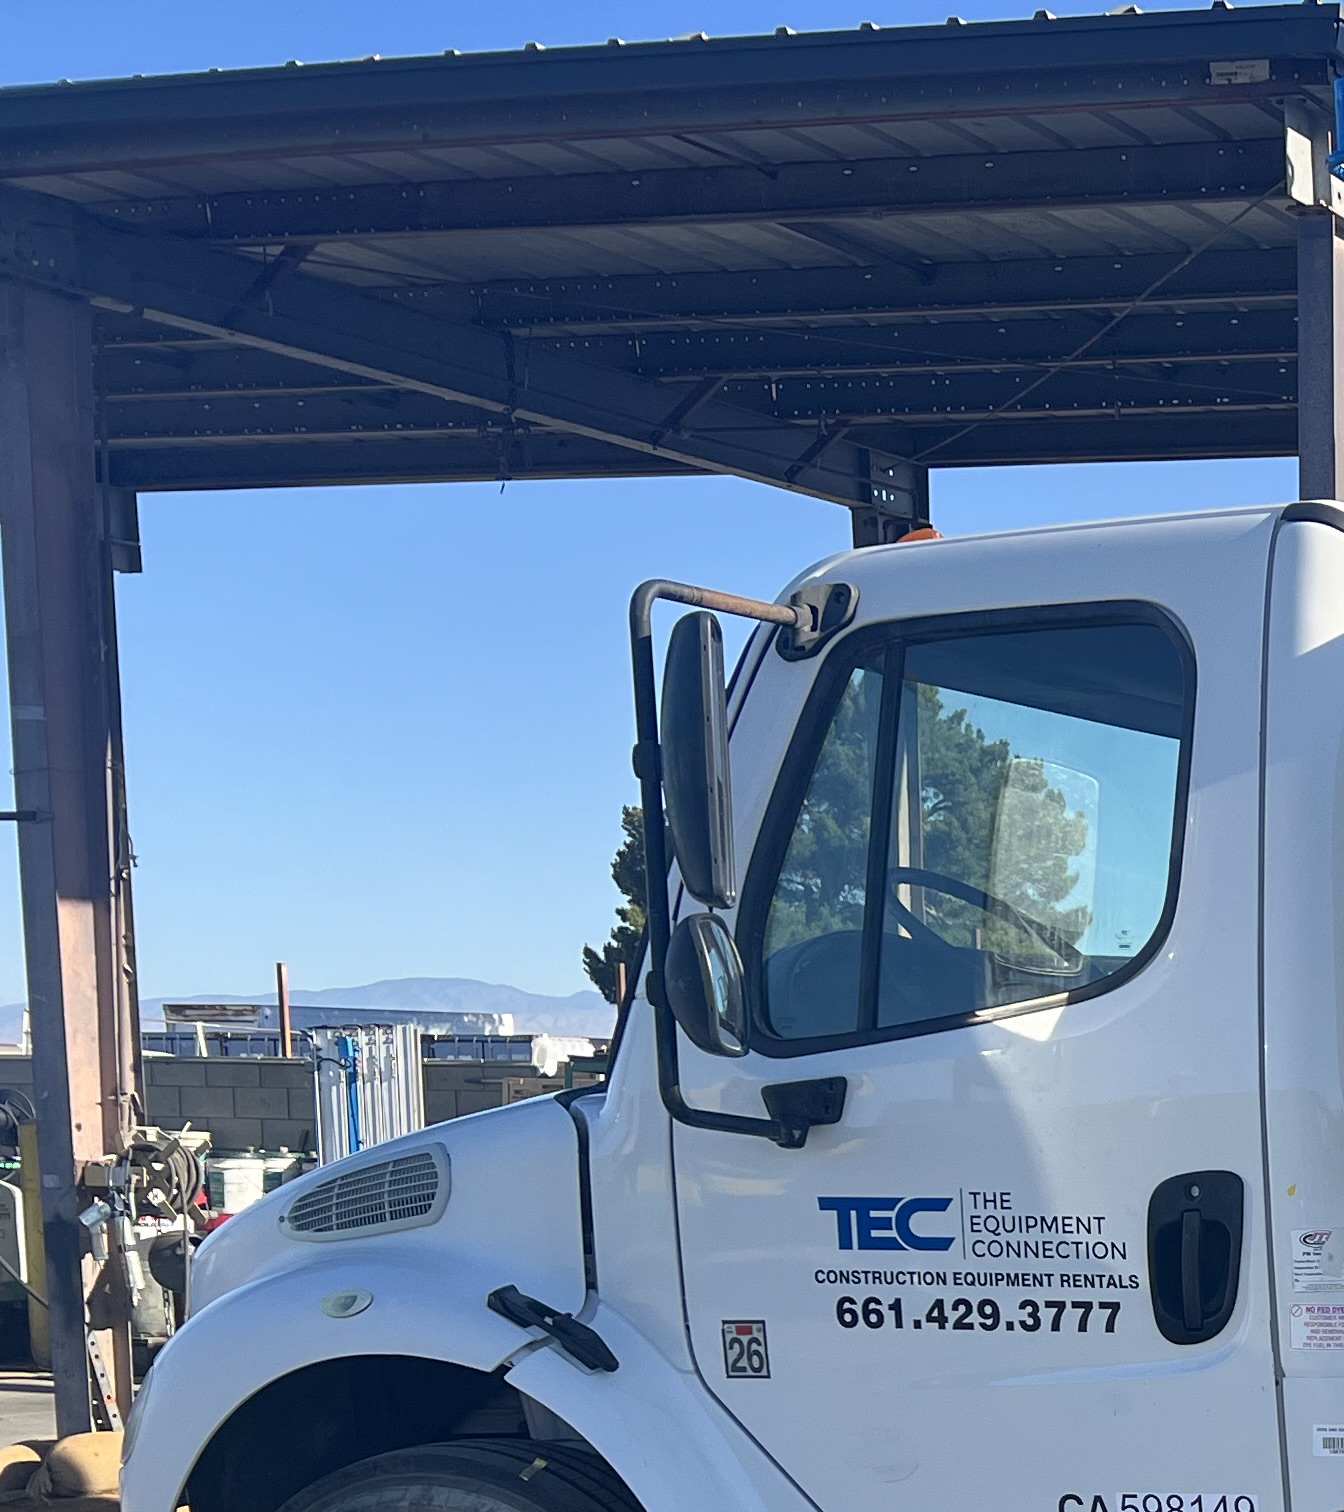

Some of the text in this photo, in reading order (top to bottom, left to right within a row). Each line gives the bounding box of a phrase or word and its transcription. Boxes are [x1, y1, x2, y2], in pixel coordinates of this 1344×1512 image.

[968, 1191, 1012, 1212] THE
[816, 1195, 954, 1251] TEC
[969, 1215, 1106, 1237] EQUIPMENT
[971, 1238, 1128, 1261] CONNECTION
[814, 1268, 1141, 1290] CONSTRUCTION EQUIPMENT RENTALS
[835, 1296, 1122, 1335] 661.429.3777
[728, 1336, 765, 1374] 26
